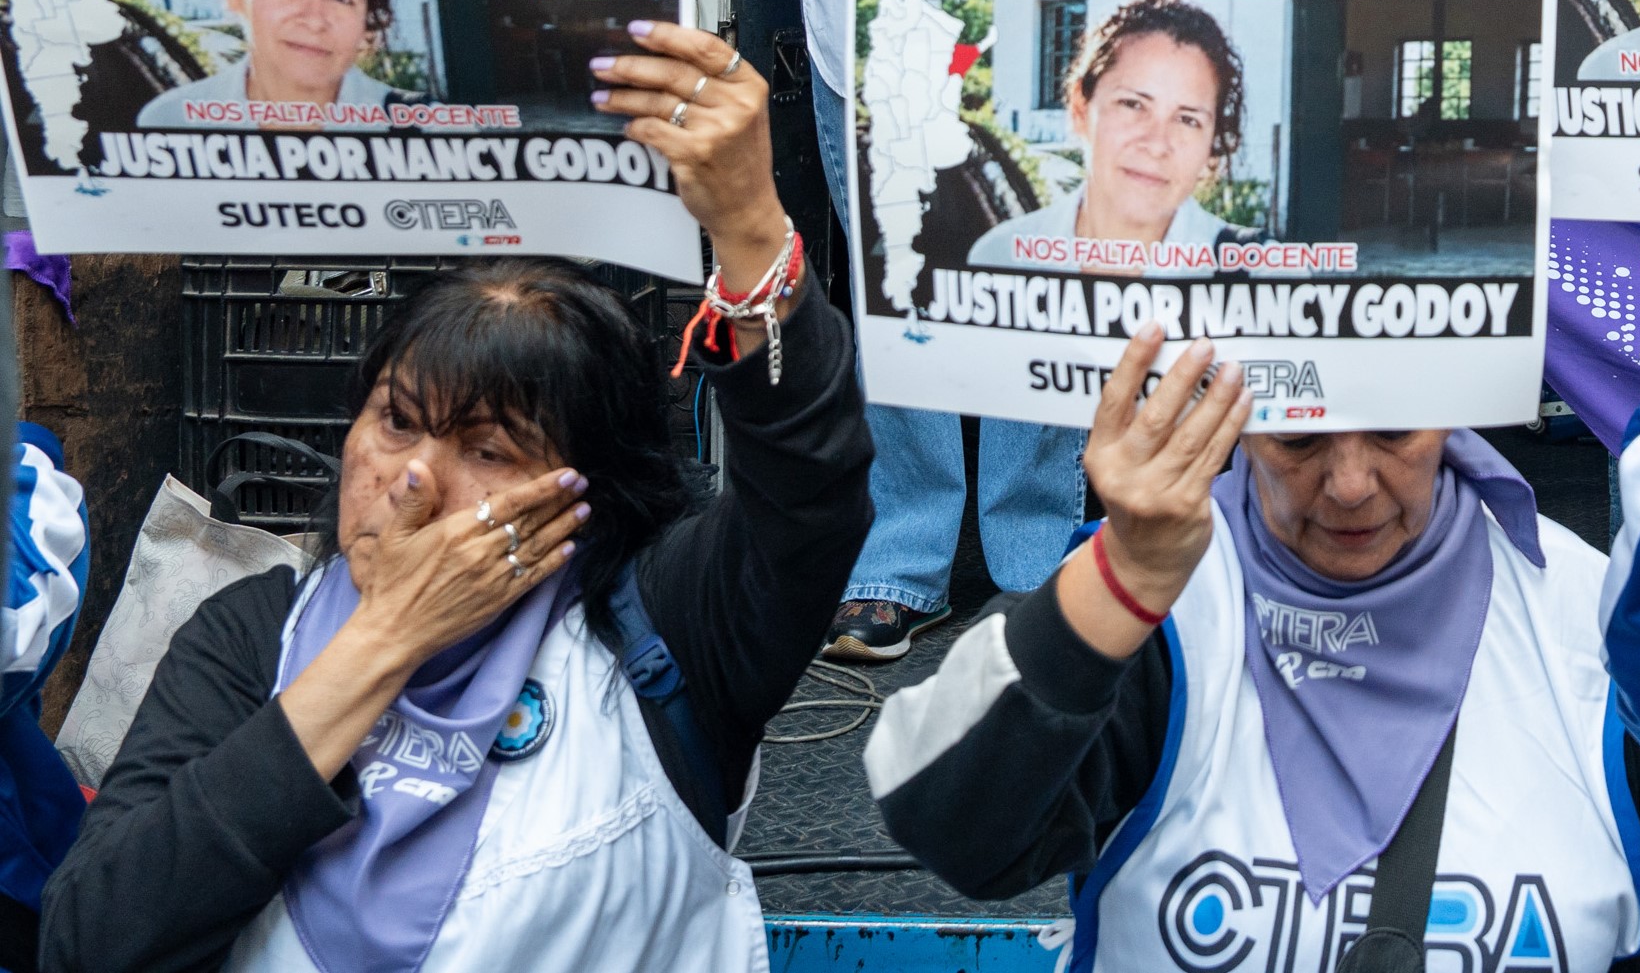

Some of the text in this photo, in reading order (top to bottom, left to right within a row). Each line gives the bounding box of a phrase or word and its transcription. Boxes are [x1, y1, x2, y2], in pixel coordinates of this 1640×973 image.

[184, 102, 520, 127] NOS FALTA UNA DOCENTE
[98, 132, 670, 190] JUSTICIA POR NANCY GODOY
[218, 199, 516, 229] SUTECO CTERA
[1014, 237, 1357, 270] NOS FALTA UNA DOCENTE
[925, 270, 1521, 341] JUSTICIA POR NANCY GODOY
